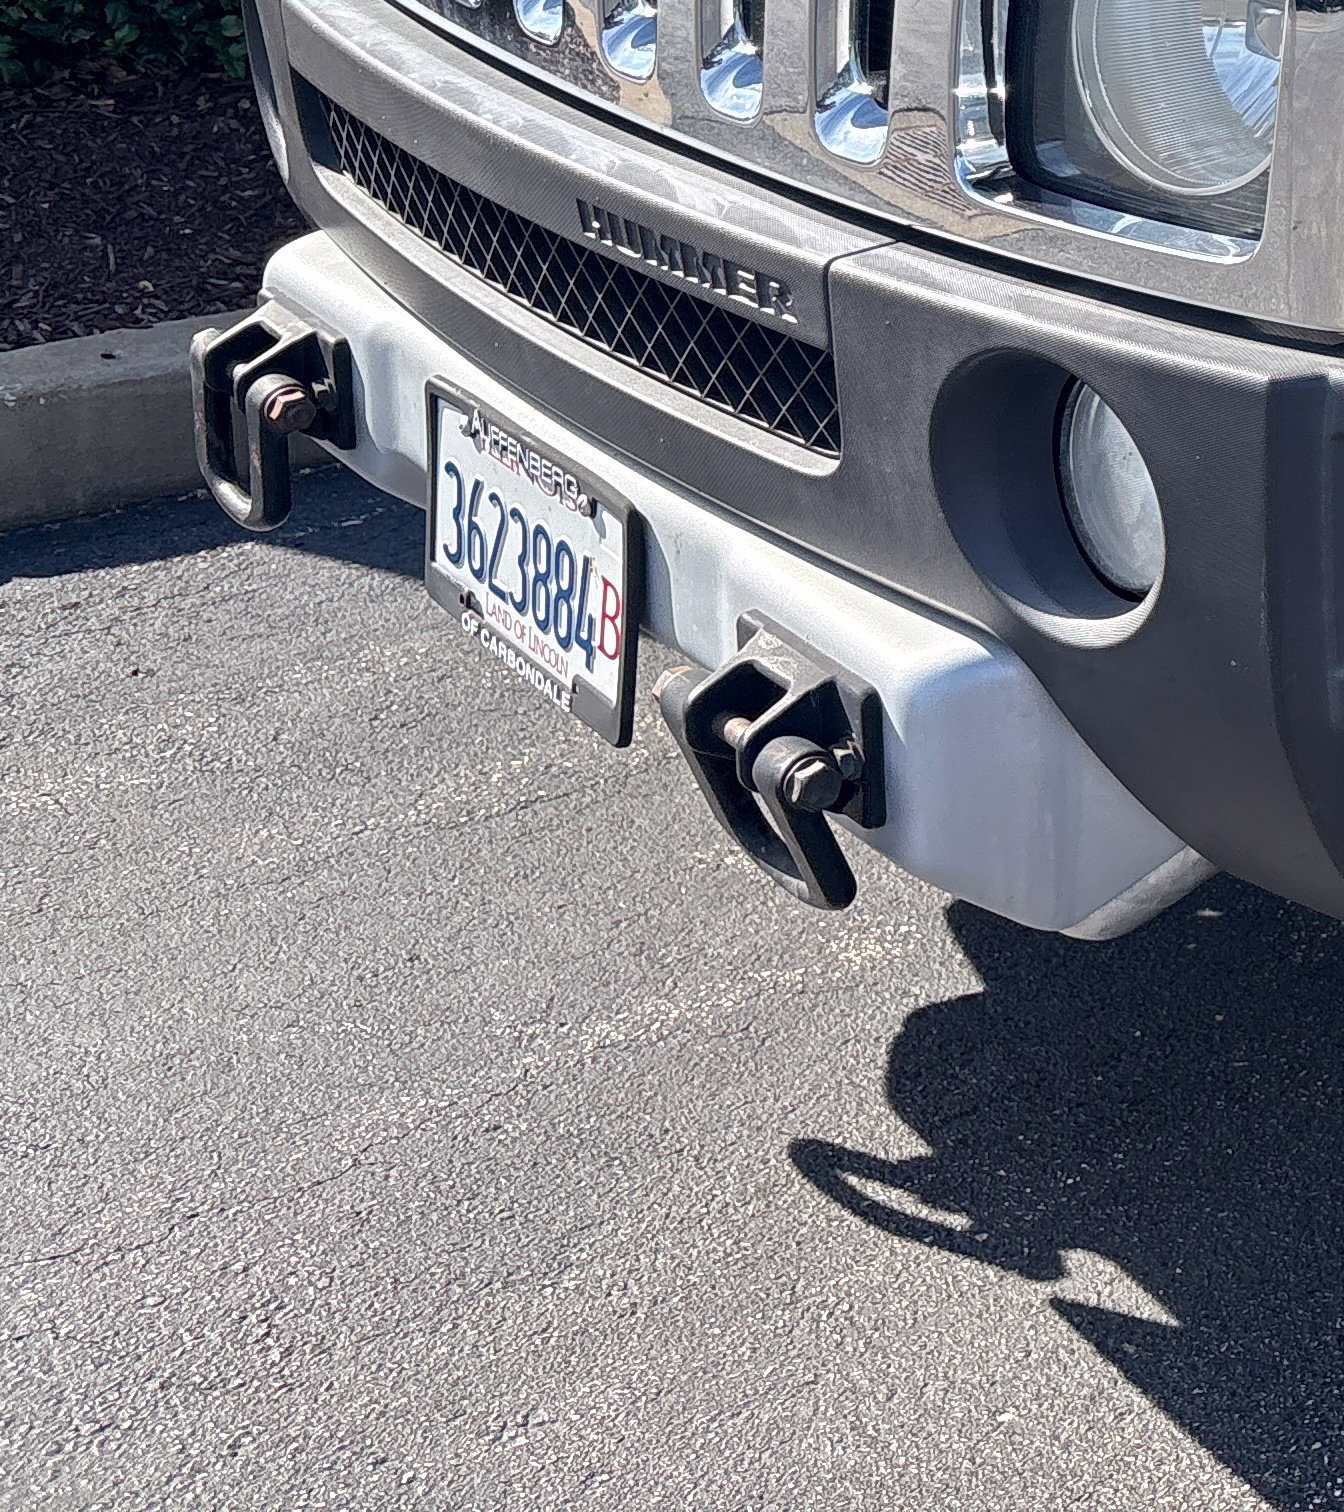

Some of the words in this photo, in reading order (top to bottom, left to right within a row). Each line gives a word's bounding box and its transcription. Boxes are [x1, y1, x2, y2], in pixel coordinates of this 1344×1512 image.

[576, 197, 799, 325] HUMMER
[442, 460, 596, 675] 3623884
[597, 574, 622, 661] B
[461, 611, 480, 638] OF
[480, 627, 571, 713] CARBONDALE
[485, 591, 513, 632] LAND
[528, 626, 569, 680] LINCOLN
